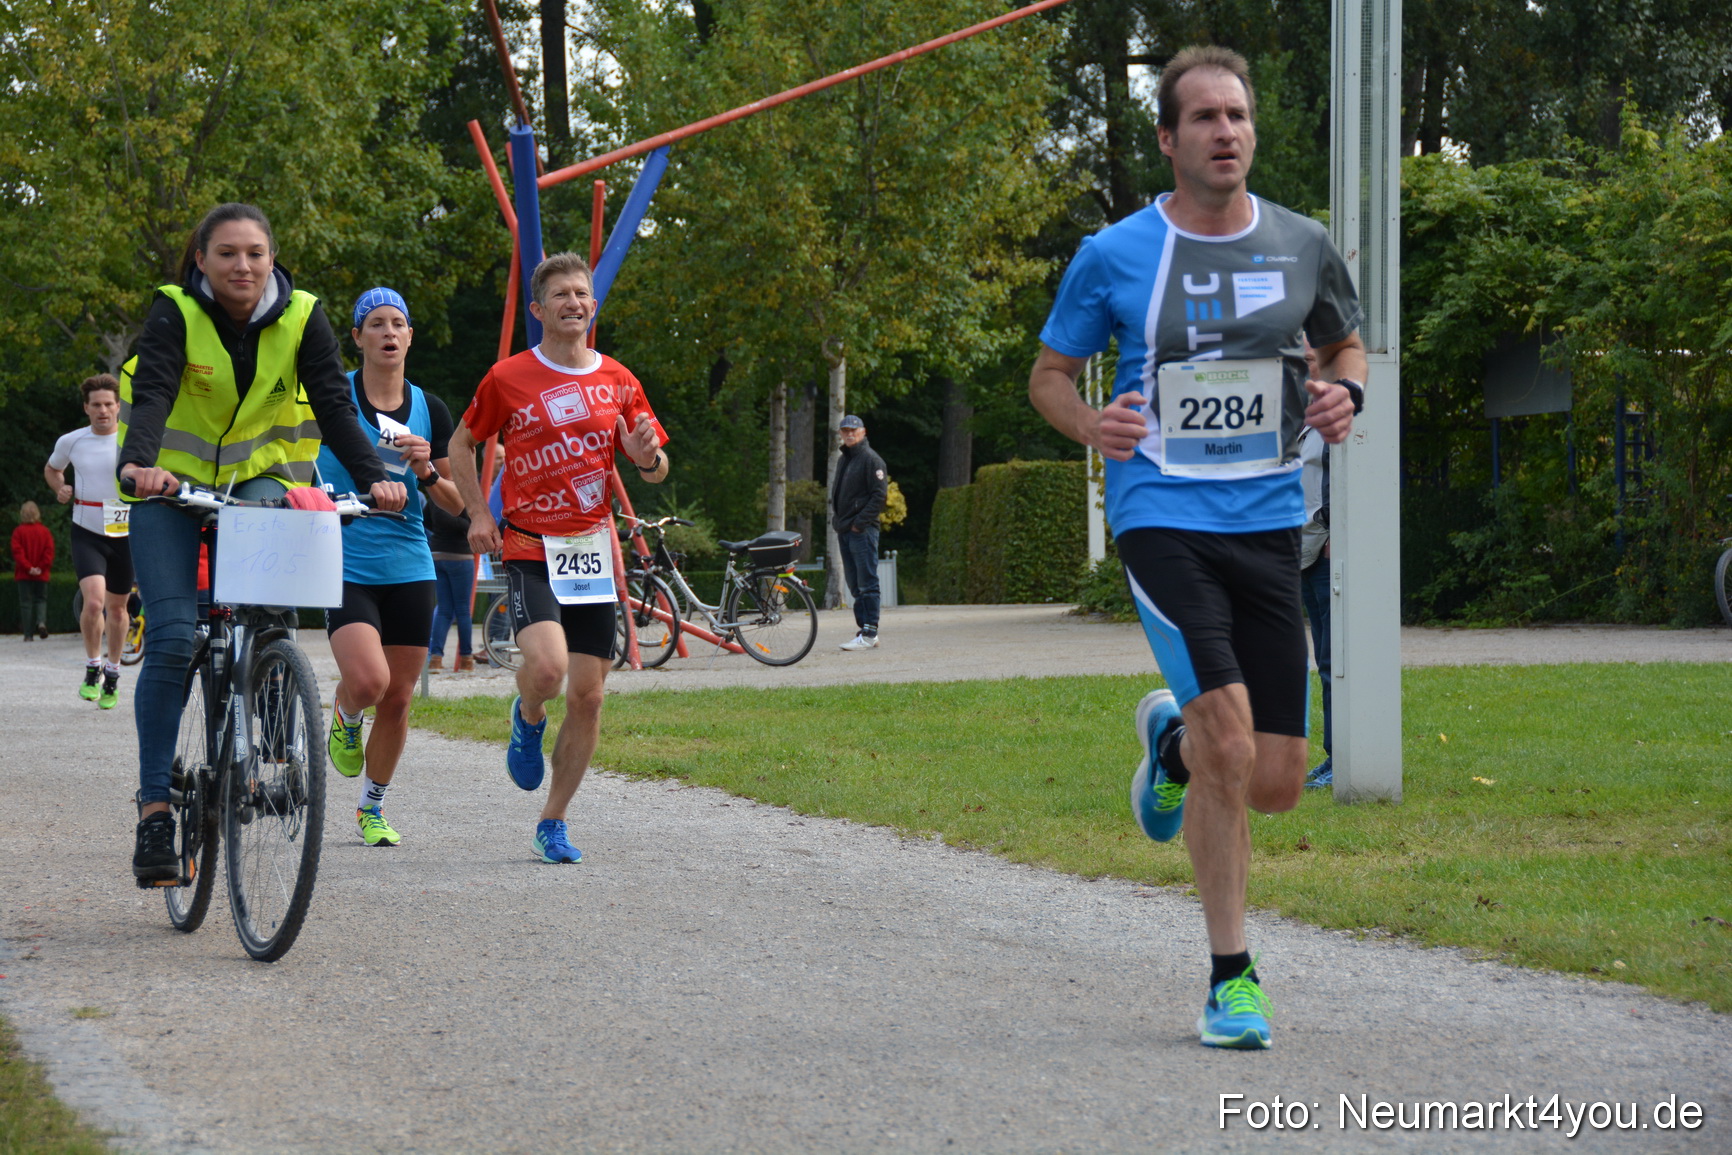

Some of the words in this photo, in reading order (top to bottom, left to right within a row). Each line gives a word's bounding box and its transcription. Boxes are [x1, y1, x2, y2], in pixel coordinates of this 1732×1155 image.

[543, 385, 579, 402] raumbox
[1179, 394, 1264, 430] 2284
[508, 428, 613, 481] raumbox
[1205, 442, 1243, 456] Martin
[549, 459, 584, 477] wohnen
[114, 510, 129, 522] 27
[233, 512, 287, 533] Erste
[536, 511, 573, 524] outdoor
[556, 552, 602, 575] 2435
[573, 582, 591, 591] Josef
